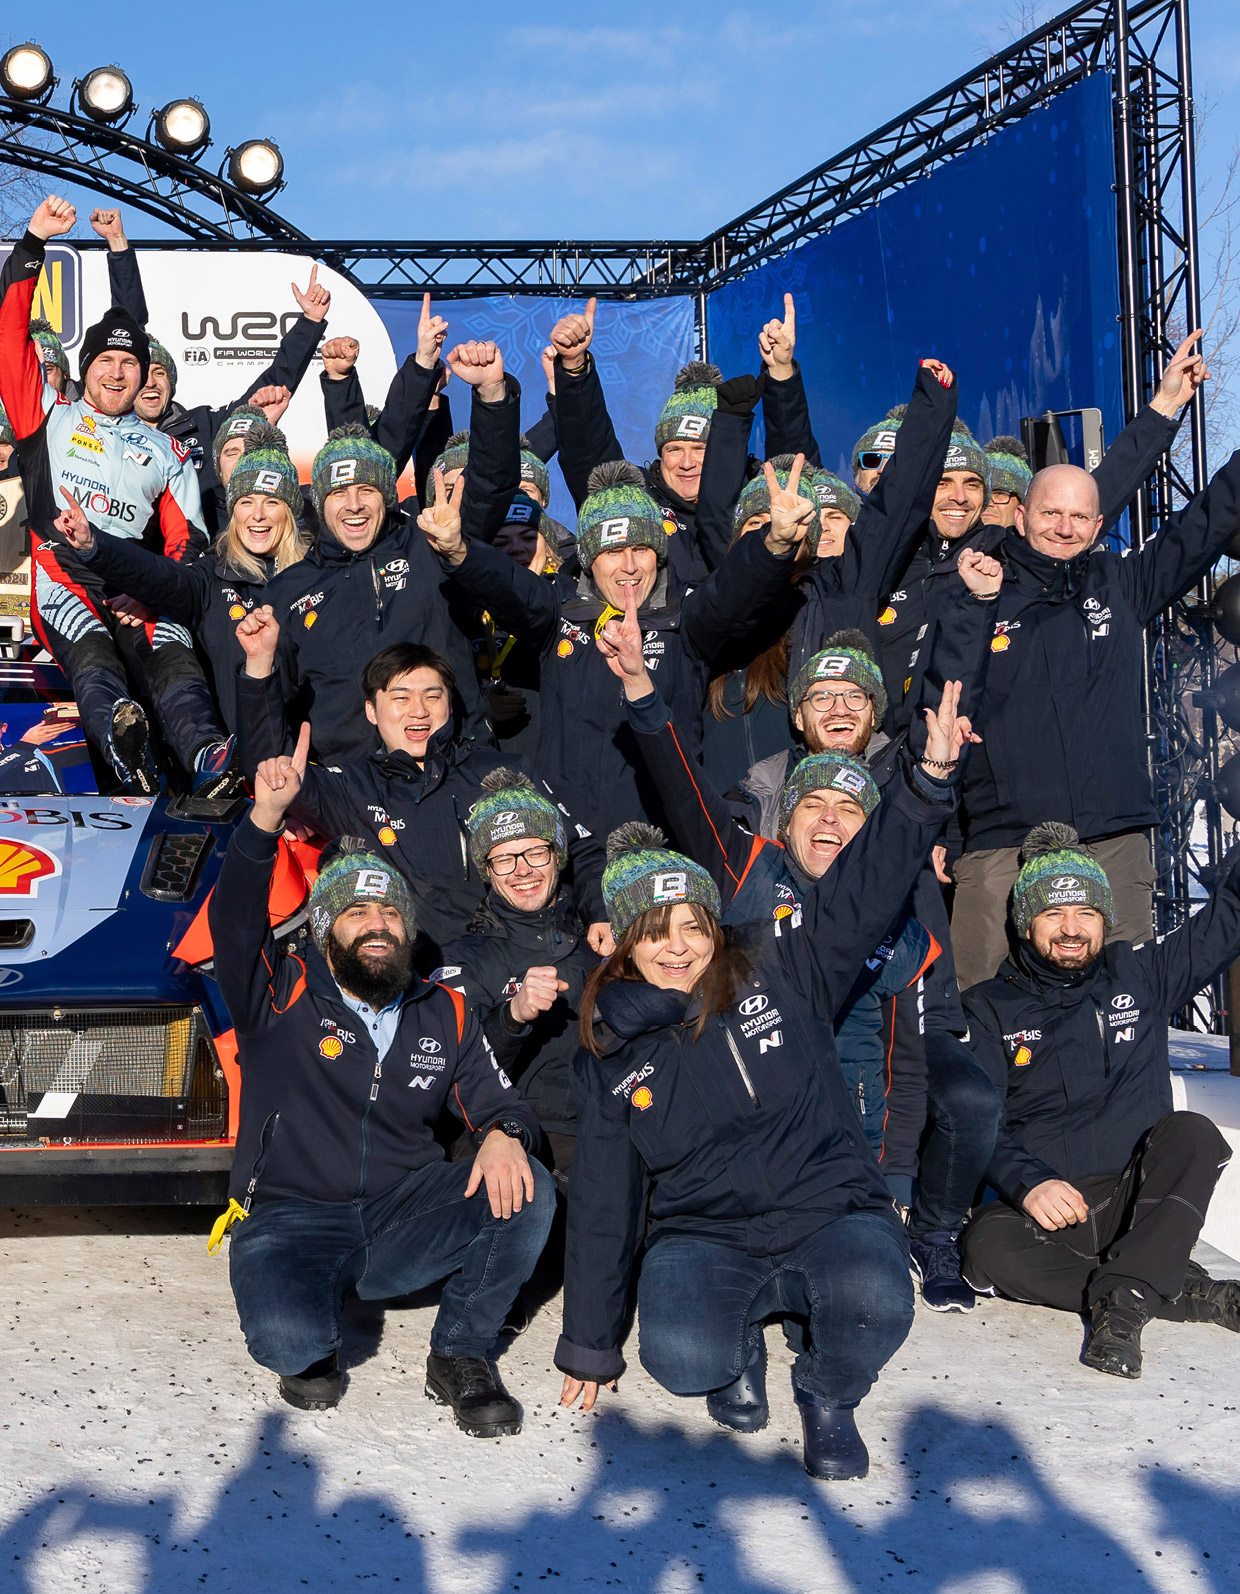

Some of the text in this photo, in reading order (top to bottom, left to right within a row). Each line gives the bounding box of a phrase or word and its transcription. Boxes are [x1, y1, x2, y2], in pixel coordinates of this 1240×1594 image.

[107, 337, 133, 345] HYUNDAI
[216, 349, 232, 358] FIA
[61, 470, 110, 496] HYUNDAI
[73, 486, 137, 522] MOBIS
[490, 822, 525, 837] HYUNDAI
[491, 829, 527, 841] MOTORSPORT
[1049, 890, 1086, 899] HYUNDAI
[740, 1008, 780, 1031] HYUNDAI
[1109, 1009, 1140, 1021] HYUNDAI
[744, 1016, 783, 1039] MOTORSPORT
[1110, 1016, 1139, 1027] MOTORSPORT
[410, 1053, 446, 1066] HYUNDAI
[410, 1061, 446, 1072] MOTORSPORT
[612, 1071, 638, 1097] HYUNDAI
